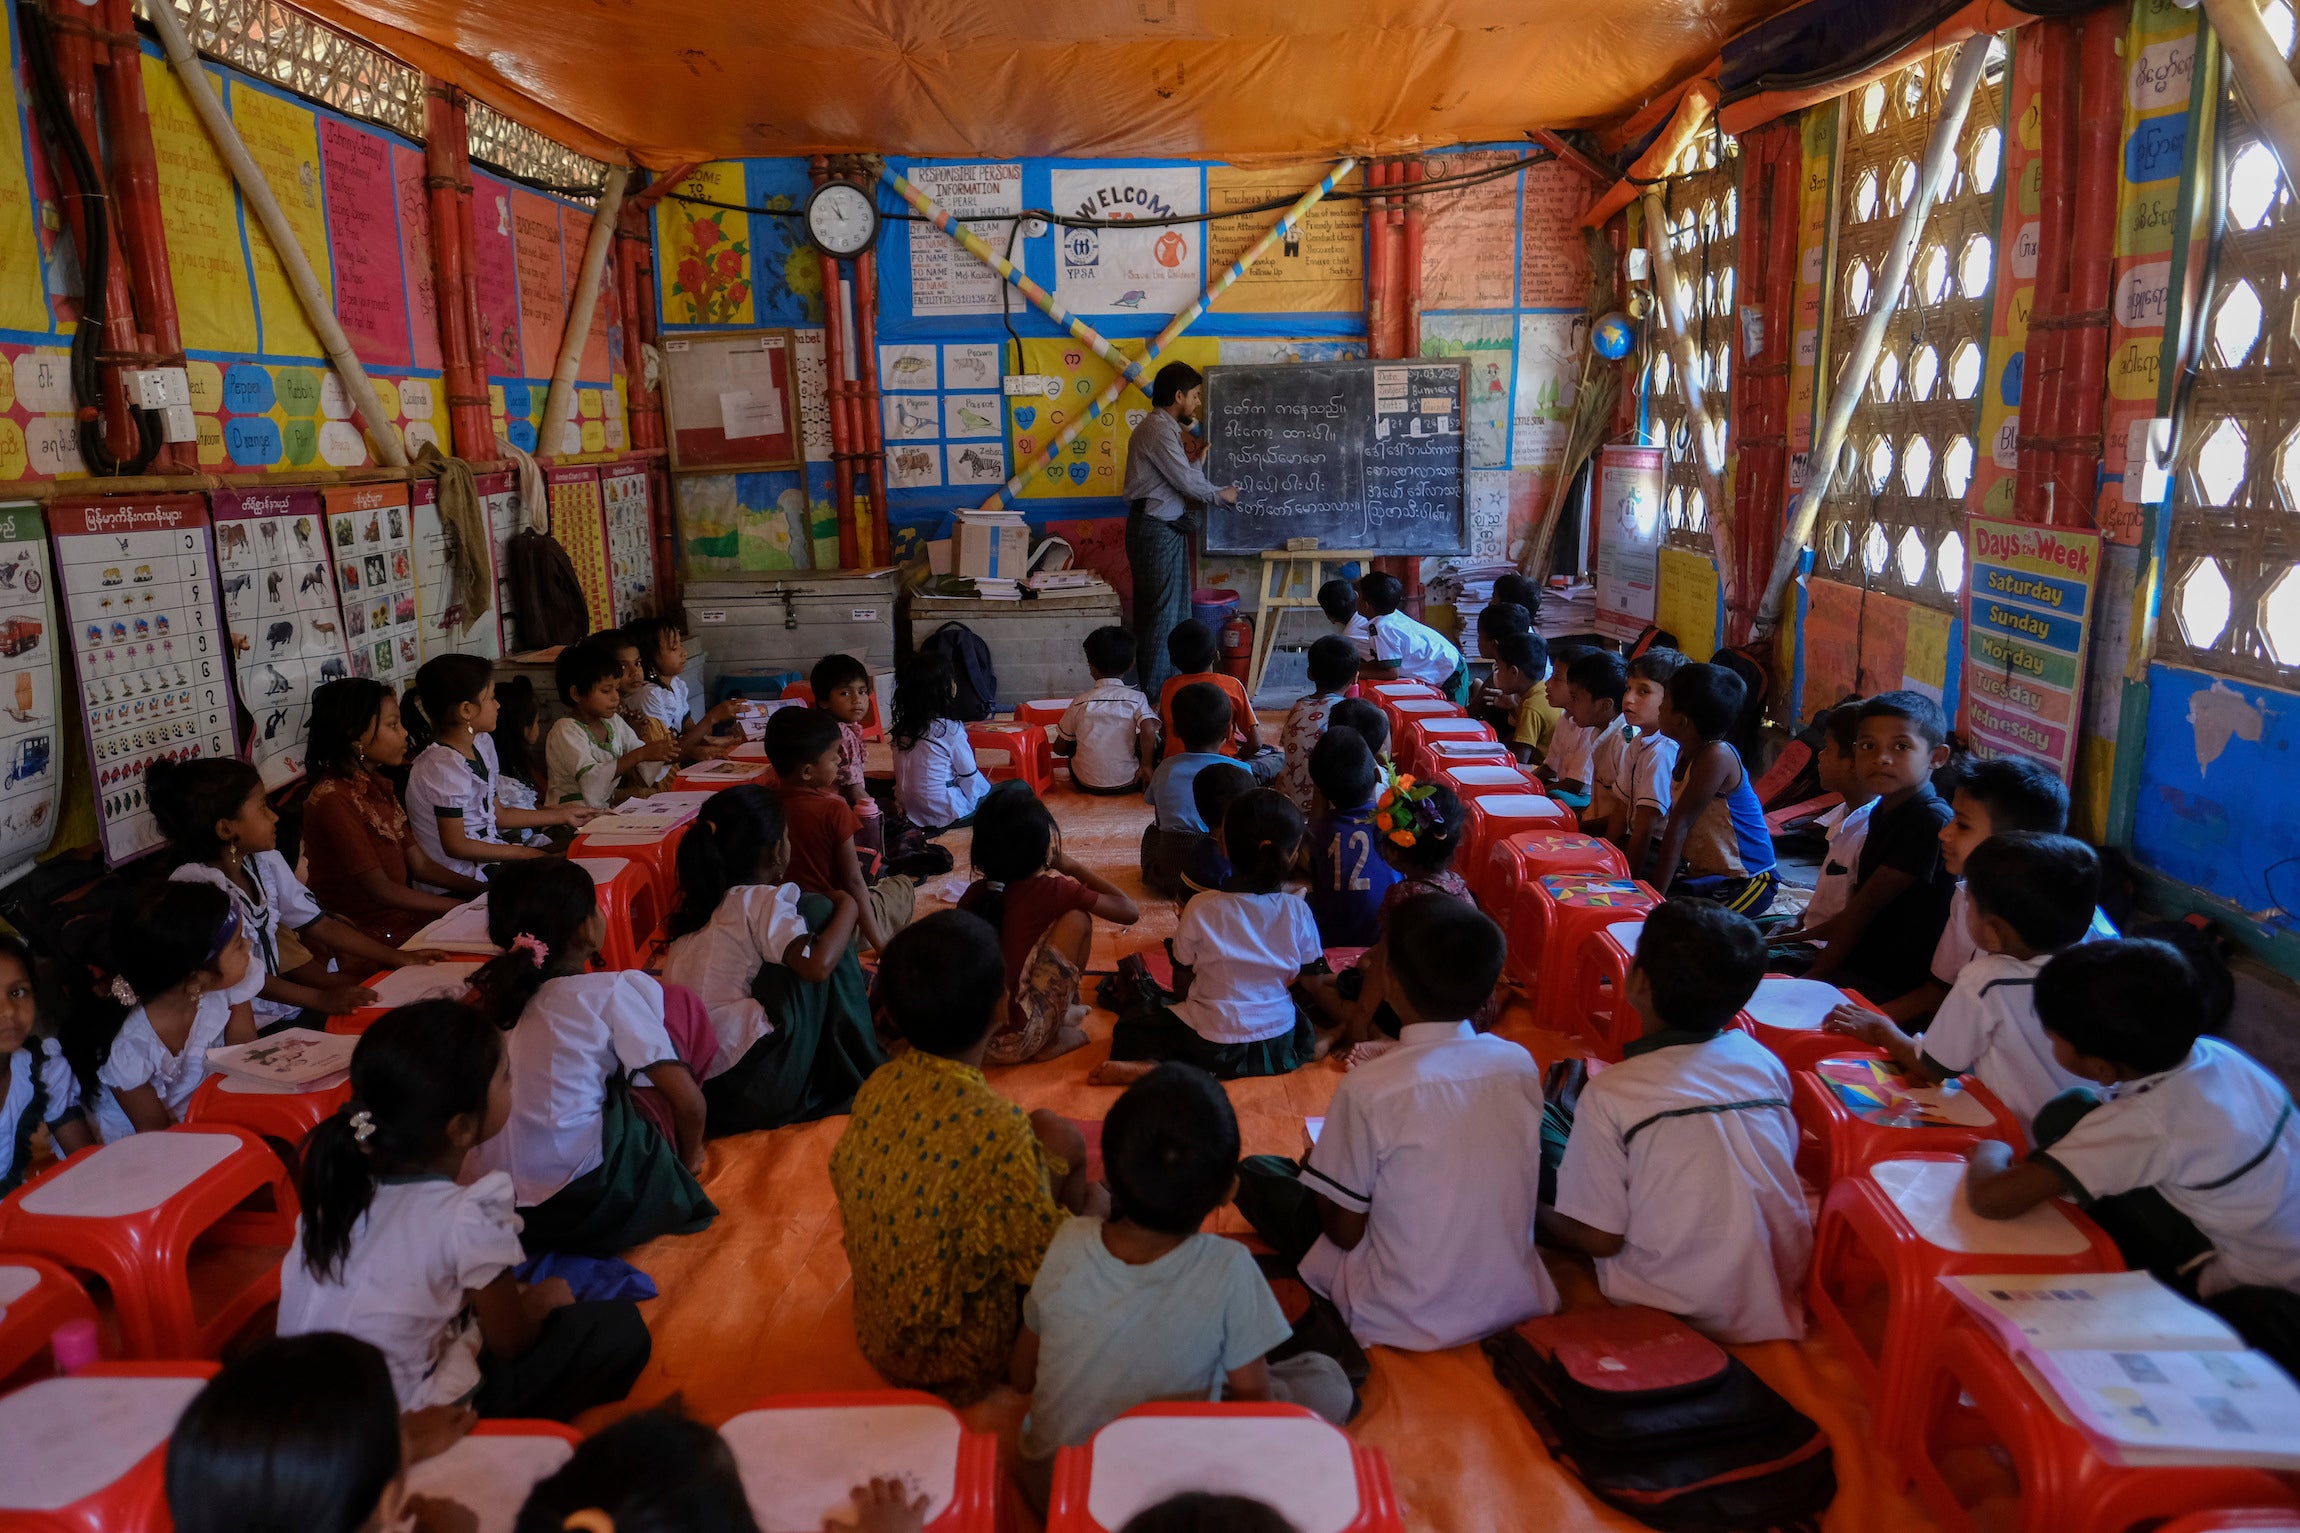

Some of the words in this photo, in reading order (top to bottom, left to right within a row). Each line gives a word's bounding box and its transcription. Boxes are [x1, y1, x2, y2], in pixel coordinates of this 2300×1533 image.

[919, 167, 977, 183] RESPONSIBLE
[979, 164, 1022, 181] PERSONS
[688, 183, 704, 194] TO
[936, 182, 1001, 197] INFORMATION
[857, 201, 864, 209] 2
[953, 197, 977, 207] PEARL
[1075, 186, 1178, 227] WELCOM
[862, 212, 869, 222] 3
[1305, 208, 1319, 218] Use
[1321, 208, 1329, 218] of
[1305, 220, 1332, 233] Friendly
[841, 238, 849, 248] 6
[853, 234, 861, 243] 5
[1212, 234, 1255, 243] Assessment
[1305, 232, 1337, 243] Conduct
[1337, 232, 1356, 242] class
[1332, 256, 1350, 266] child
[1066, 268, 1096, 280] YPSA
[1064, 353, 1081, 366] က
[1377, 371, 1400, 382] Date:
[189, 380, 205, 394] eat
[1076, 379, 1091, 394] ဂ
[1050, 410, 1064, 425] င
[233, 427, 272, 456] Orange
[1975, 527, 2021, 561] Days
[2022, 543, 2036, 557] the
[2035, 529, 2090, 576] Week
[1987, 571, 2063, 608] Saturday
[1988, 605, 2050, 640] Sunday
[1981, 638, 2044, 676] Monday
[1976, 671, 2043, 712] Tuesday
[1327, 830, 1371, 891] 12
